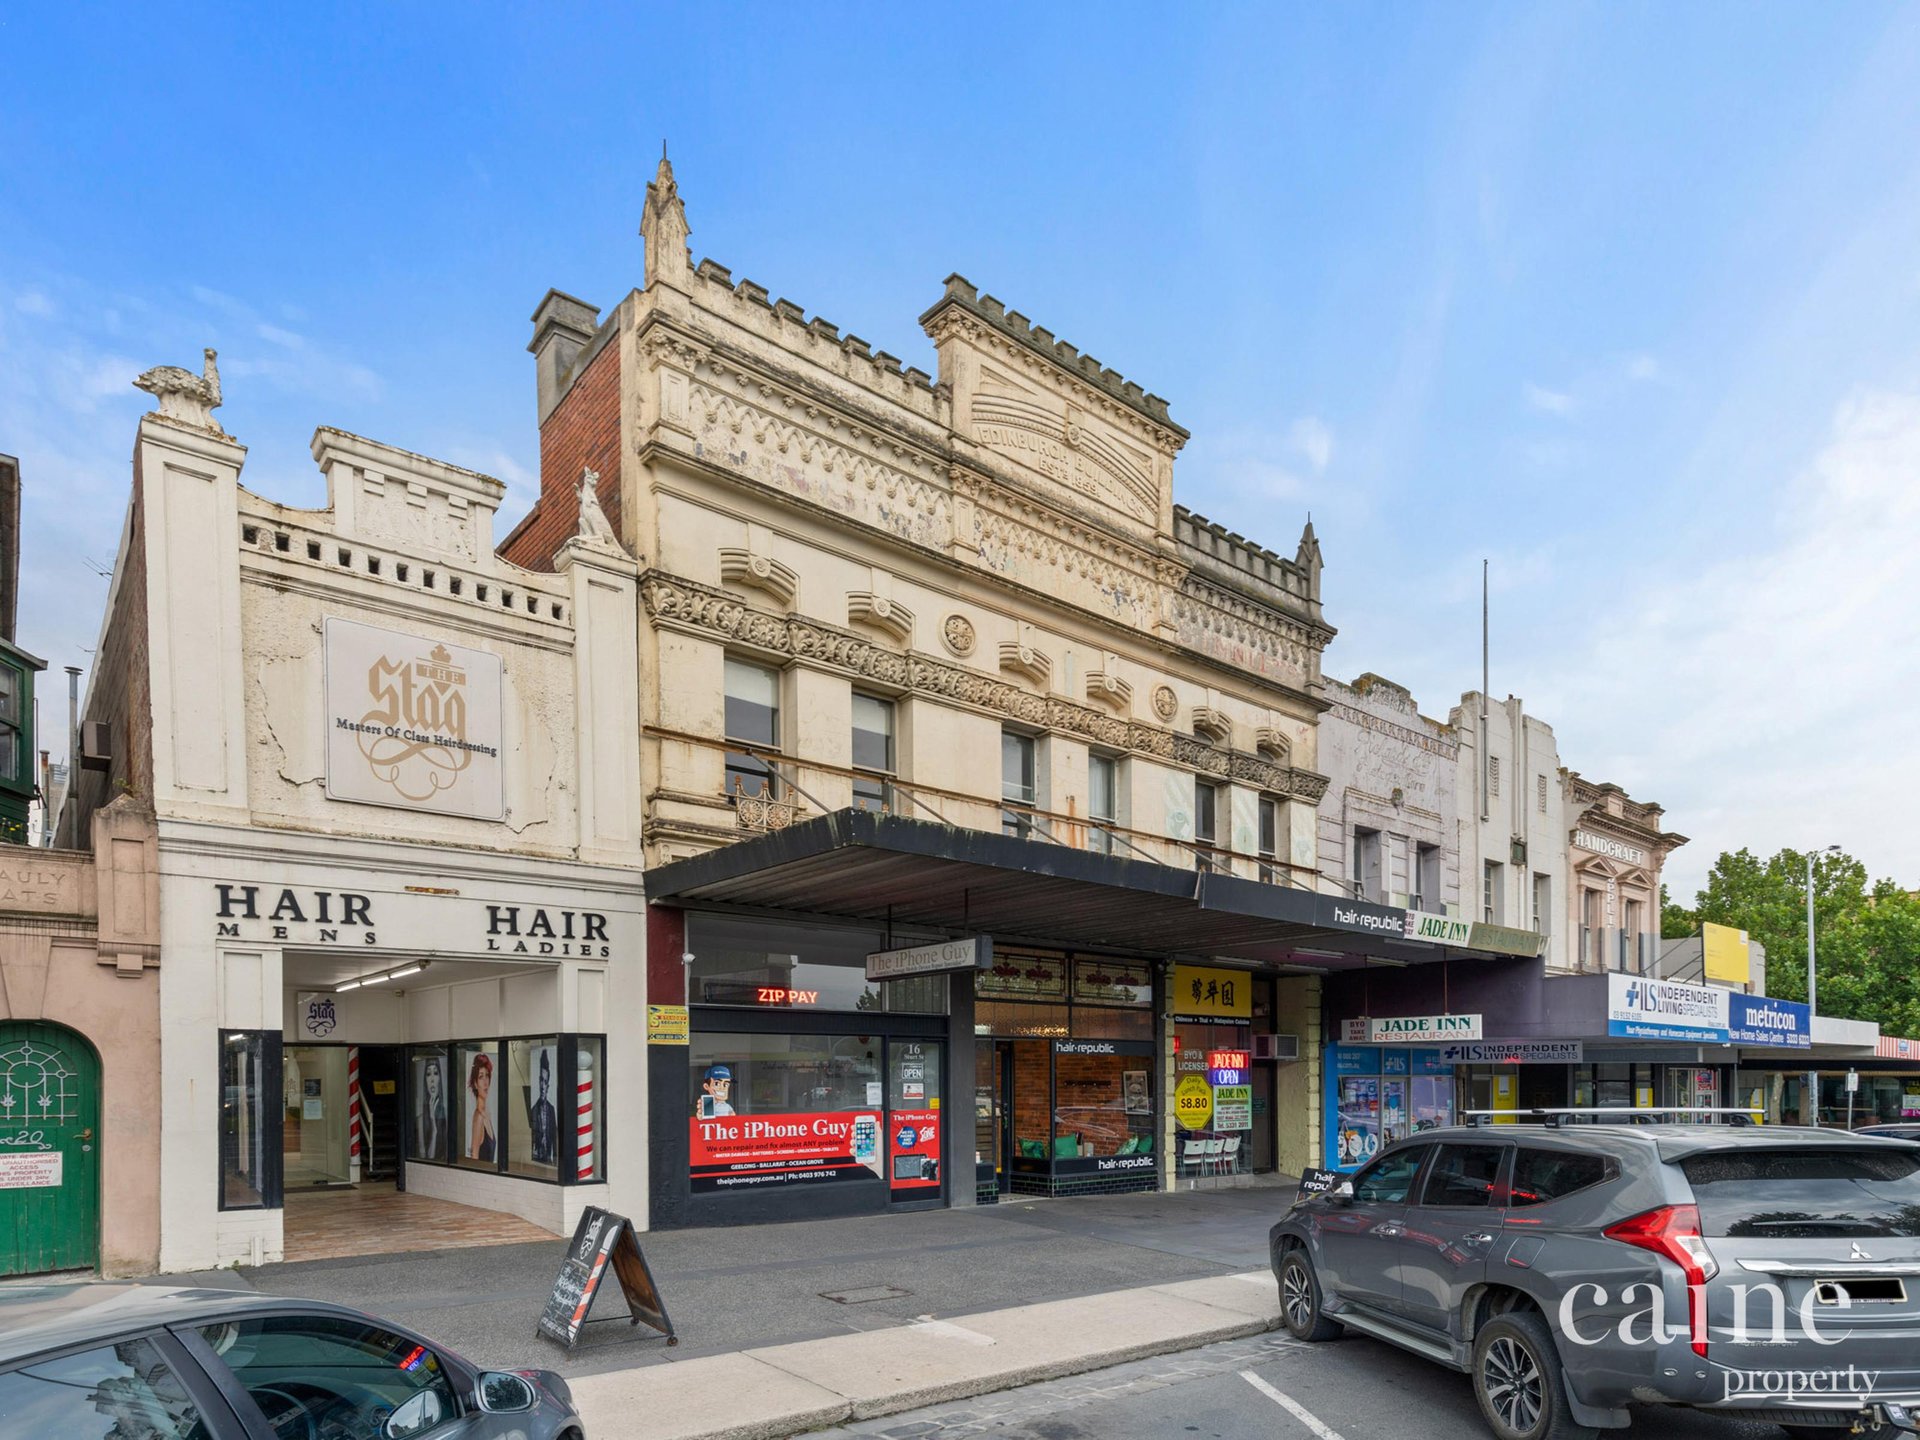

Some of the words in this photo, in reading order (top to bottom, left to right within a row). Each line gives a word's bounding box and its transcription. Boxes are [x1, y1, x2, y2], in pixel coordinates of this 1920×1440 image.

[423, 666, 460, 682] THE
[336, 717, 382, 735] Masters
[385, 726, 401, 738] Of
[403, 729, 430, 744] Class
[433, 735, 497, 757] Hairdressing
[1576, 830, 1643, 864] HANDCRAFT
[214, 884, 375, 926] HAIR
[485, 905, 610, 941] HAIR
[1417, 917, 1449, 938] JADE
[1448, 922, 1470, 942] INN
[216, 922, 376, 945] MENS
[487, 939, 610, 957] LADIES
[869, 955, 892, 972] The
[896, 950, 938, 967] iPhone
[942, 944, 971, 963] Guy
[758, 988, 785, 1003] ZIP
[789, 991, 819, 1003] PAY
[1640, 982, 1657, 1012] ILS
[1657, 985, 1718, 1005] INDEPENDENT
[1746, 1001, 1796, 1031] metricon
[1380, 1019, 1430, 1032] JADE
[1437, 1017, 1471, 1030] INN
[1374, 1030, 1476, 1041] RESTAURANT
[1728, 1027, 1740, 1040] New
[1740, 1028, 1755, 1041] Home
[1755, 1029, 1769, 1041] Sales
[909, 1044, 921, 1055] 16
[1184, 1050, 1198, 1060] BYO
[1461, 1046, 1482, 1060] ILS
[1483, 1044, 1578, 1053] INDEPENDENT
[1178, 1061, 1209, 1071] LICENSED
[1212, 1053, 1231, 1069] JADE
[1231, 1053, 1244, 1069] INN
[903, 1068, 922, 1078] OPEN
[1218, 1070, 1239, 1084] OPEN
[1217, 1088, 1236, 1099] JADE
[1180, 1097, 1208, 1109] $8.80
[925, 1113, 937, 1121] Guy
[14, 1130, 44, 1144] 20
[700, 1123, 739, 1141] The
[744, 1121, 808, 1139] iPhone
[812, 1119, 850, 1139] Guy
[733, 1143, 755, 1152] repair
[818, 1139, 845, 1148] problem
[716, 1175, 784, 1186] theiphoneguy.com.au
[1314, 1171, 1336, 1183] hair
[1303, 1180, 1329, 1191] repu
